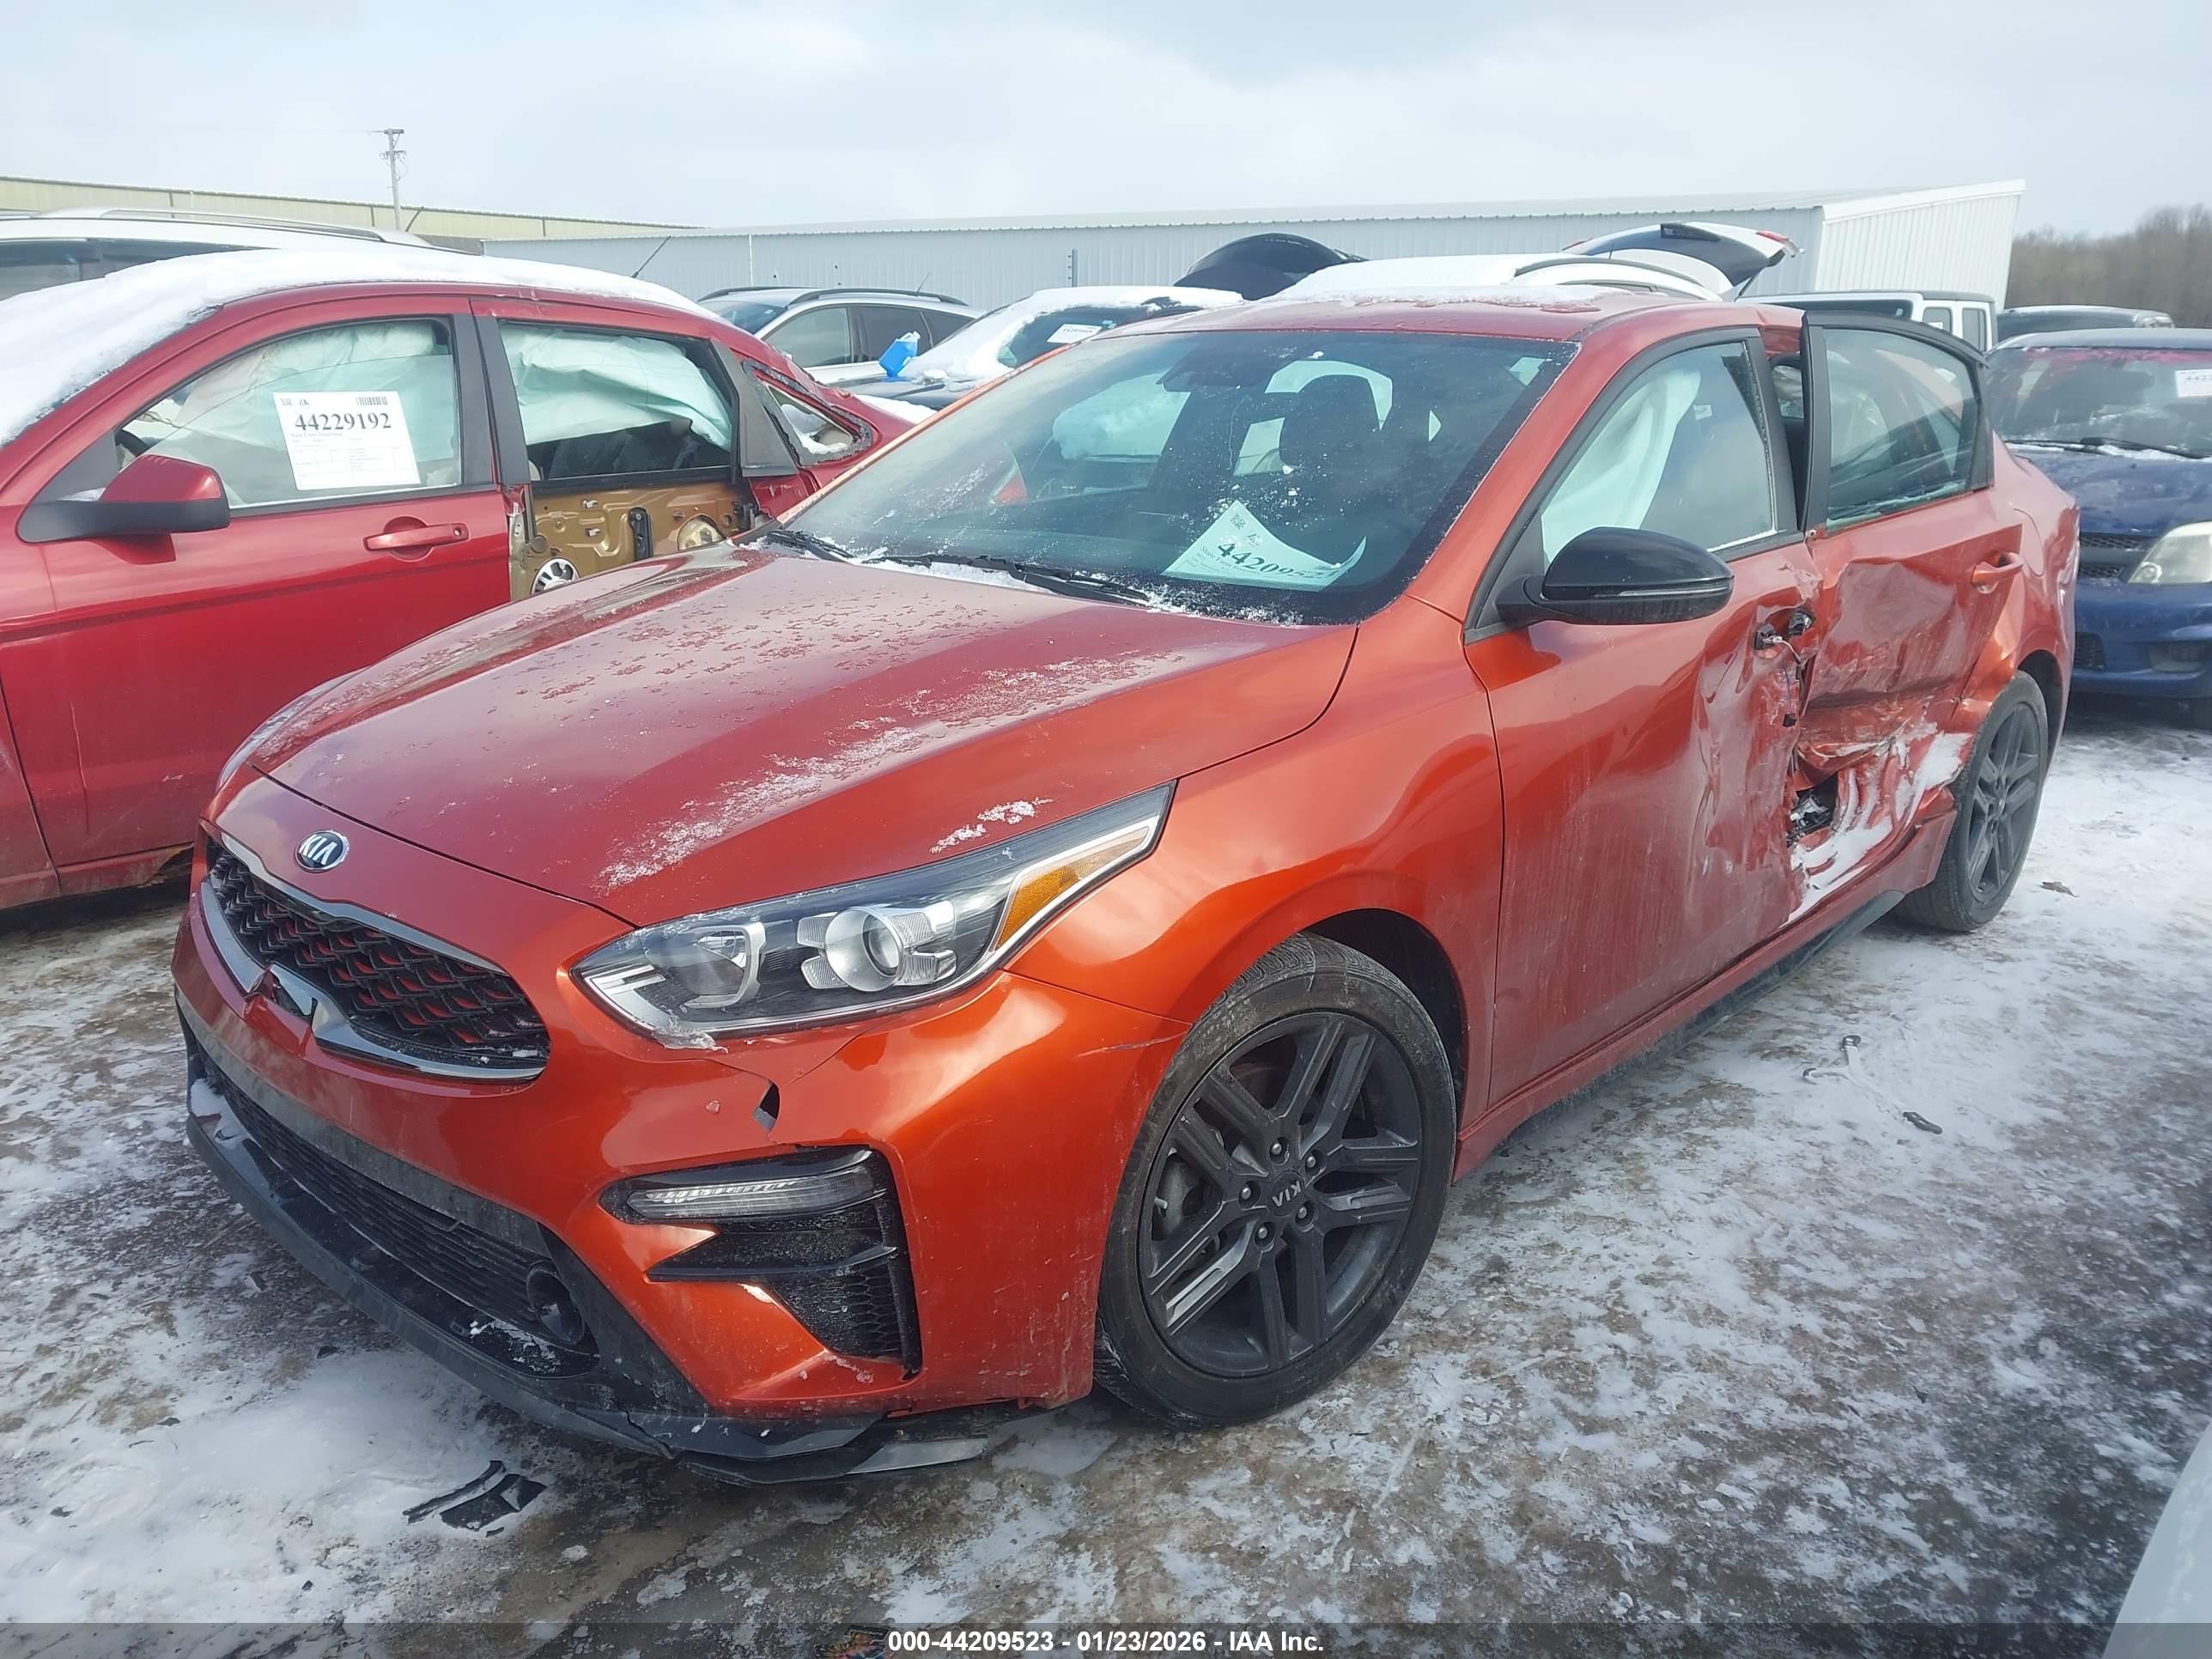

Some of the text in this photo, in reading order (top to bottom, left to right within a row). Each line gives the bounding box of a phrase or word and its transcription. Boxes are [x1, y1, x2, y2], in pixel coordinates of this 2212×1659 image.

[295, 412, 392, 430] 44229192
[297, 834, 337, 866] KIA
[1272, 1181, 1301, 1207] KIA
